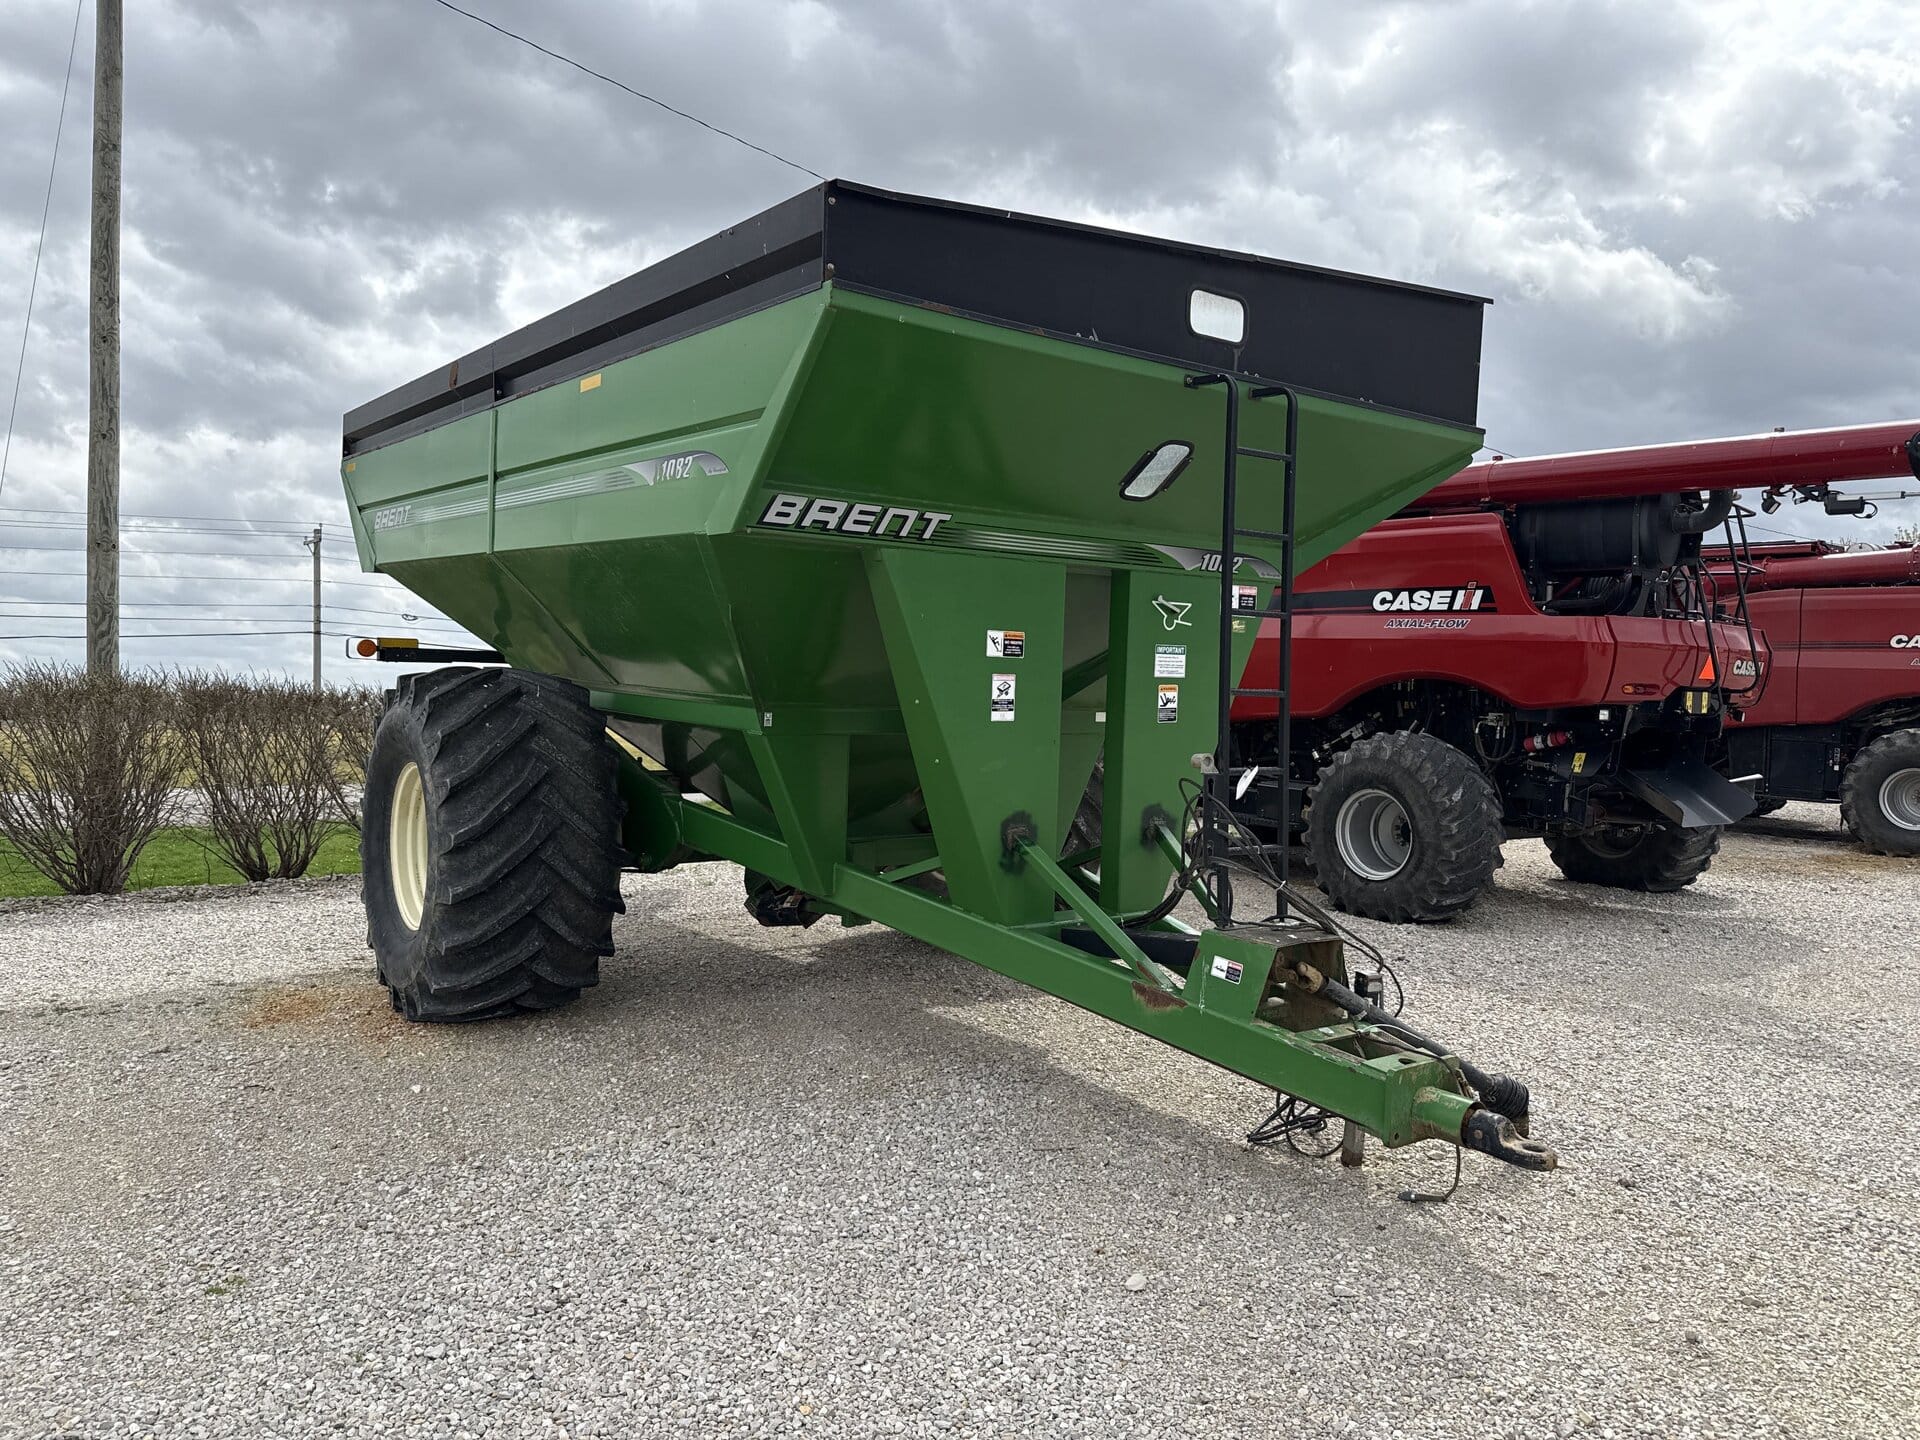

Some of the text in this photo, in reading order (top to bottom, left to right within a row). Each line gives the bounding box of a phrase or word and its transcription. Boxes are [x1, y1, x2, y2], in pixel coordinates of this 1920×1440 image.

[374, 505, 412, 529] BRENT
[760, 493, 954, 540] BRENT
[1200, 553, 1244, 574] 102
[1372, 590, 1453, 611] CASE
[1384, 618, 1471, 629] AXIAL-FLOW
[1156, 646, 1185, 654] IMPORTANT
